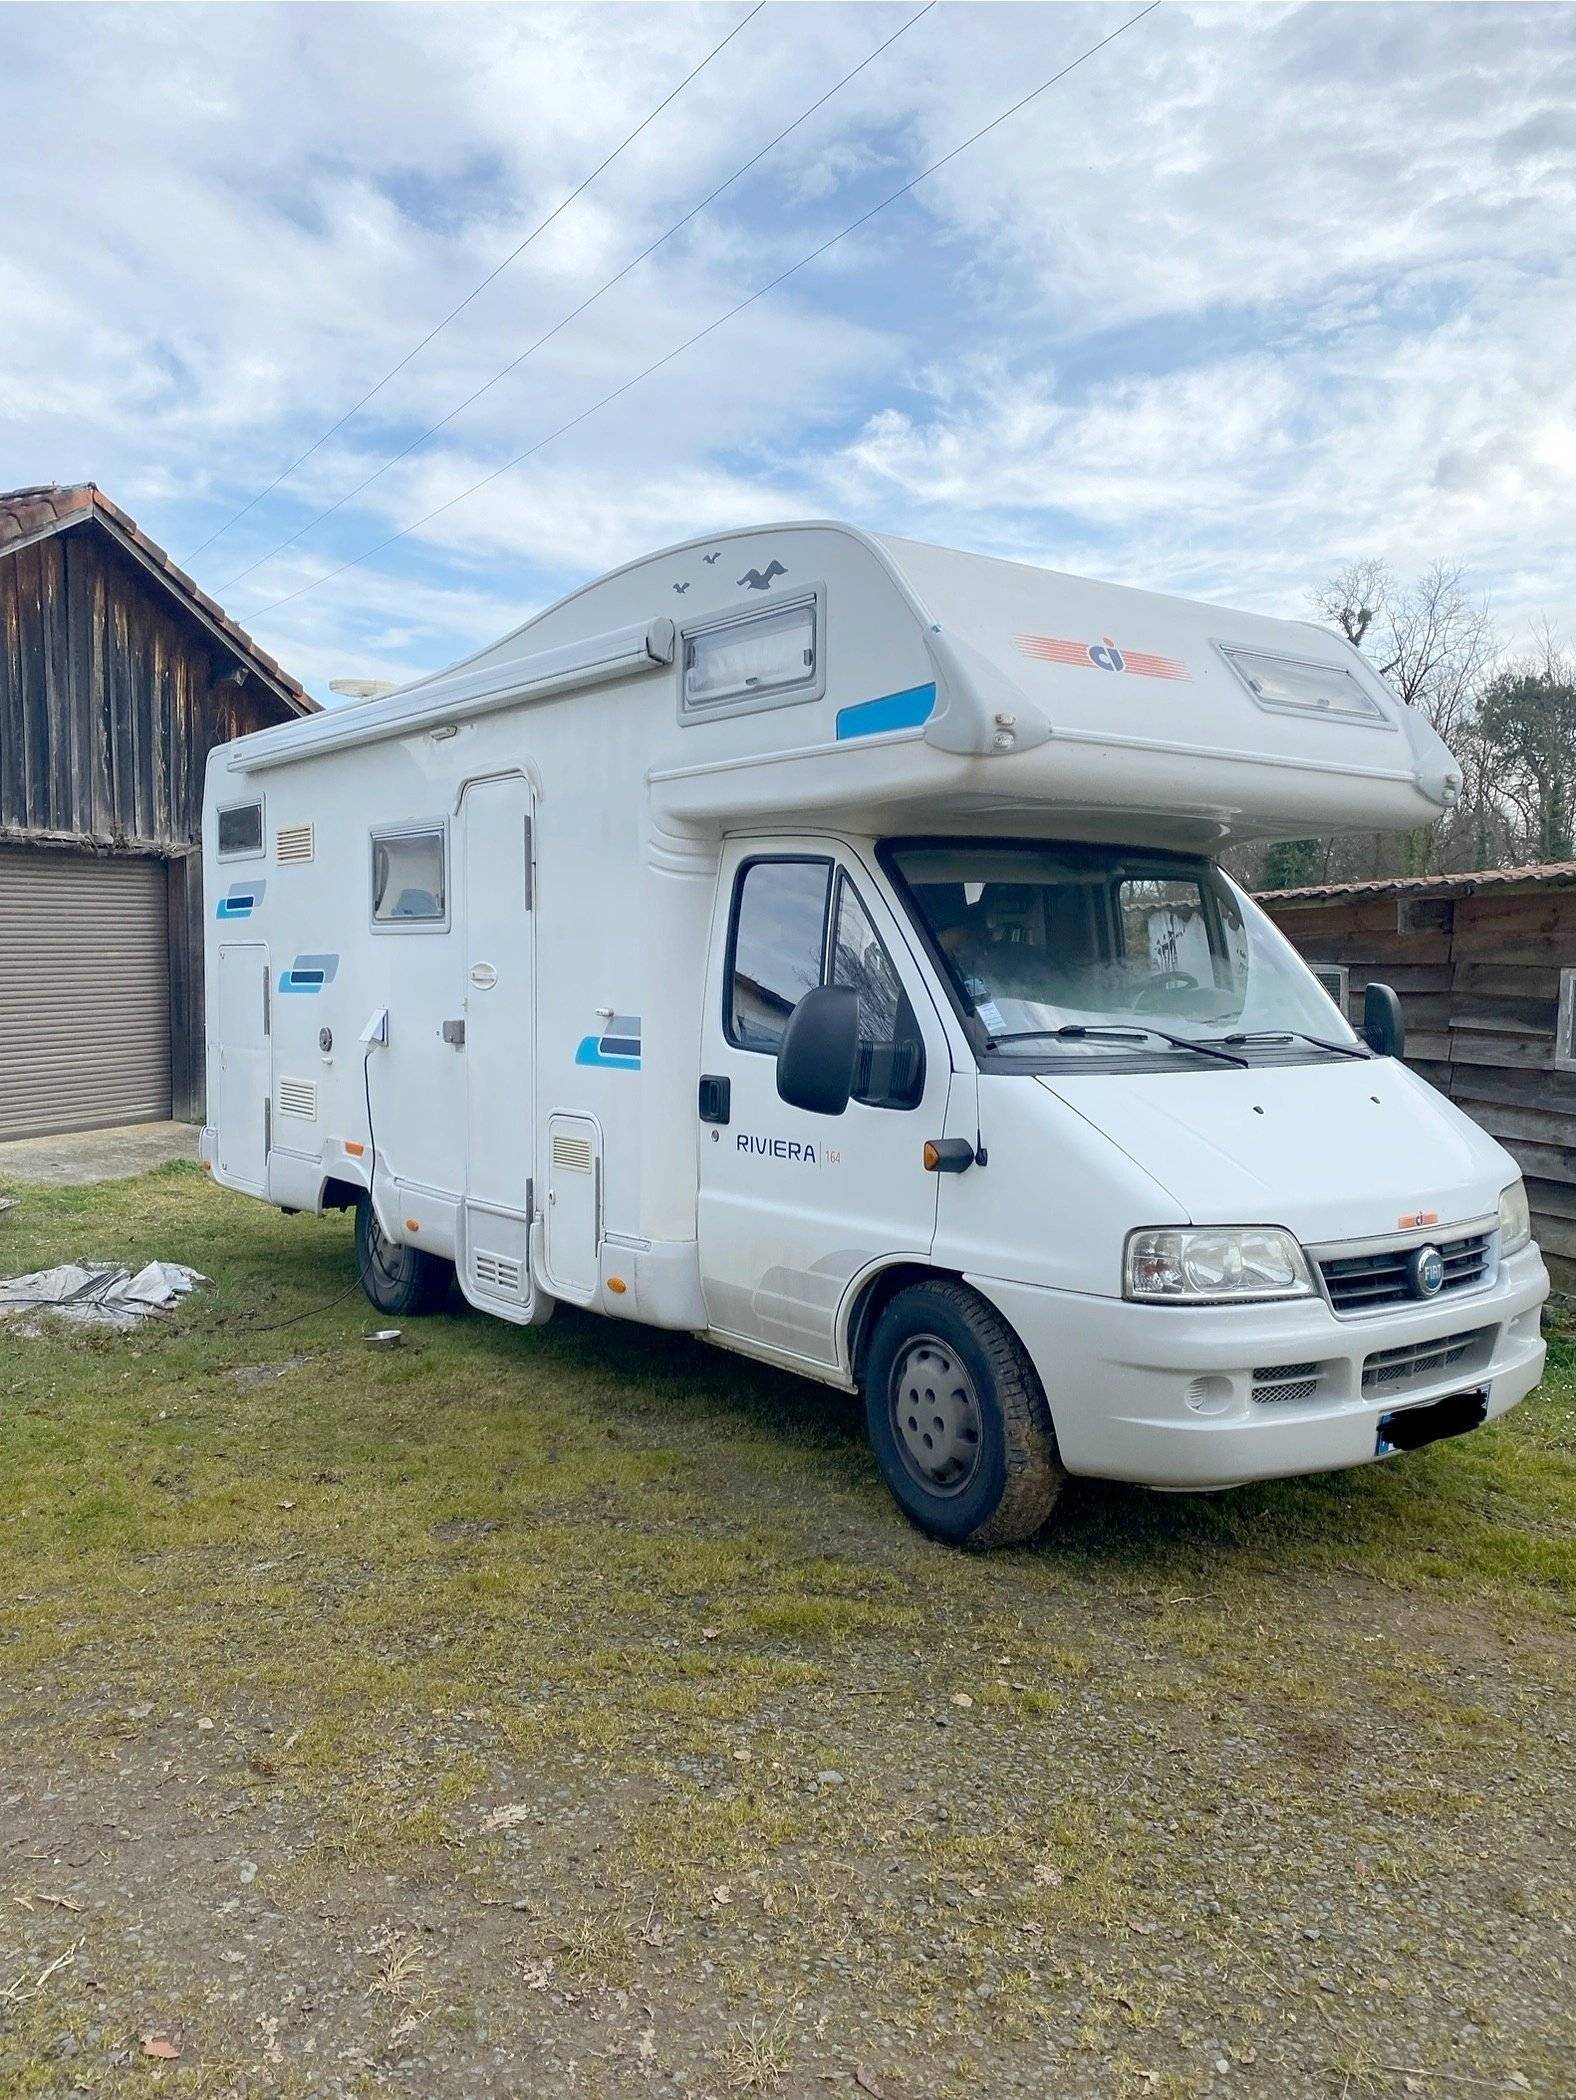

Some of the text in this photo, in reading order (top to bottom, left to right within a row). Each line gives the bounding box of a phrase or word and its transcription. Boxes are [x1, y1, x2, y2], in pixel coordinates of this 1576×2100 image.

[736, 1134, 841, 1164] RIVIERA 164
[1424, 1263, 1442, 1281] FIAT
